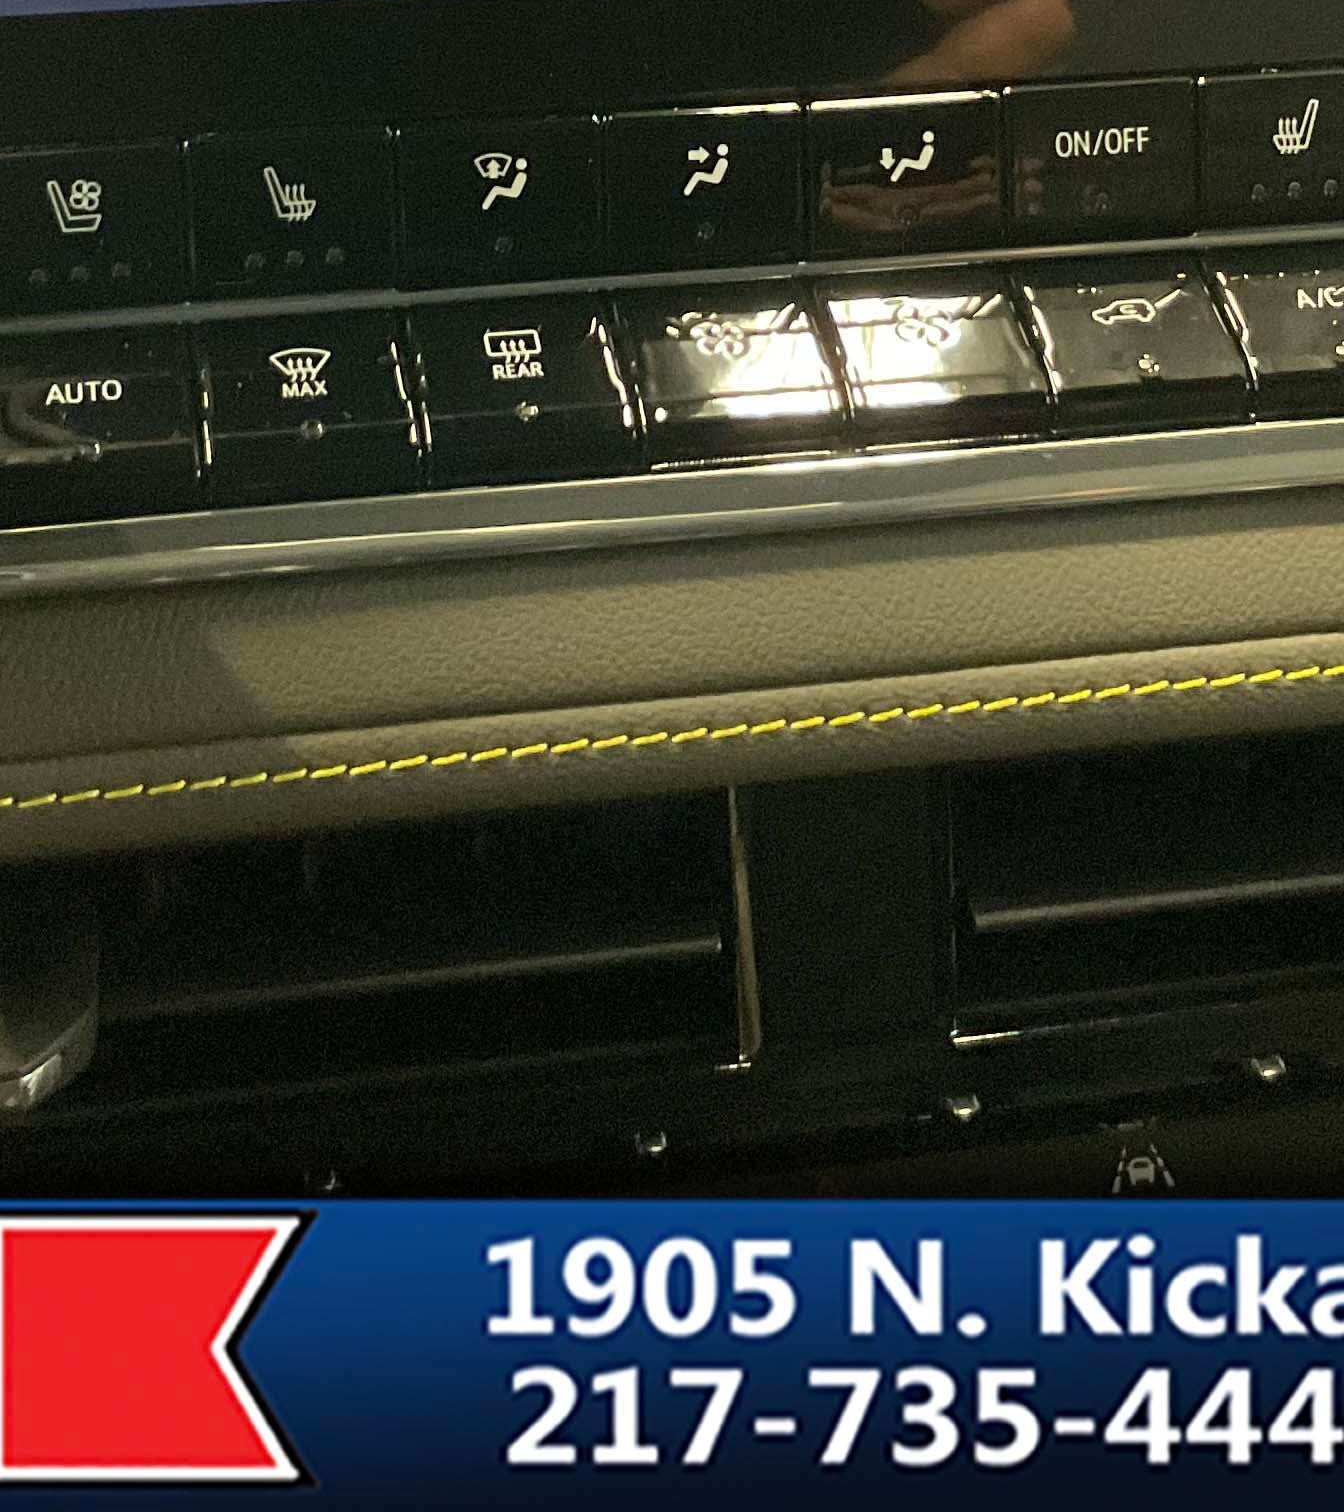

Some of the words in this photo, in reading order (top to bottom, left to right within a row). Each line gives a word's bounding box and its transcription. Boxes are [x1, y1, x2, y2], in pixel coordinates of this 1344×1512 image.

[1055, 127, 1149, 157] ON/OFF
[1296, 285, 1343, 309] A/C
[492, 359, 545, 380] REAR
[45, 379, 123, 406] AUTO
[281, 378, 329, 398] MAX
